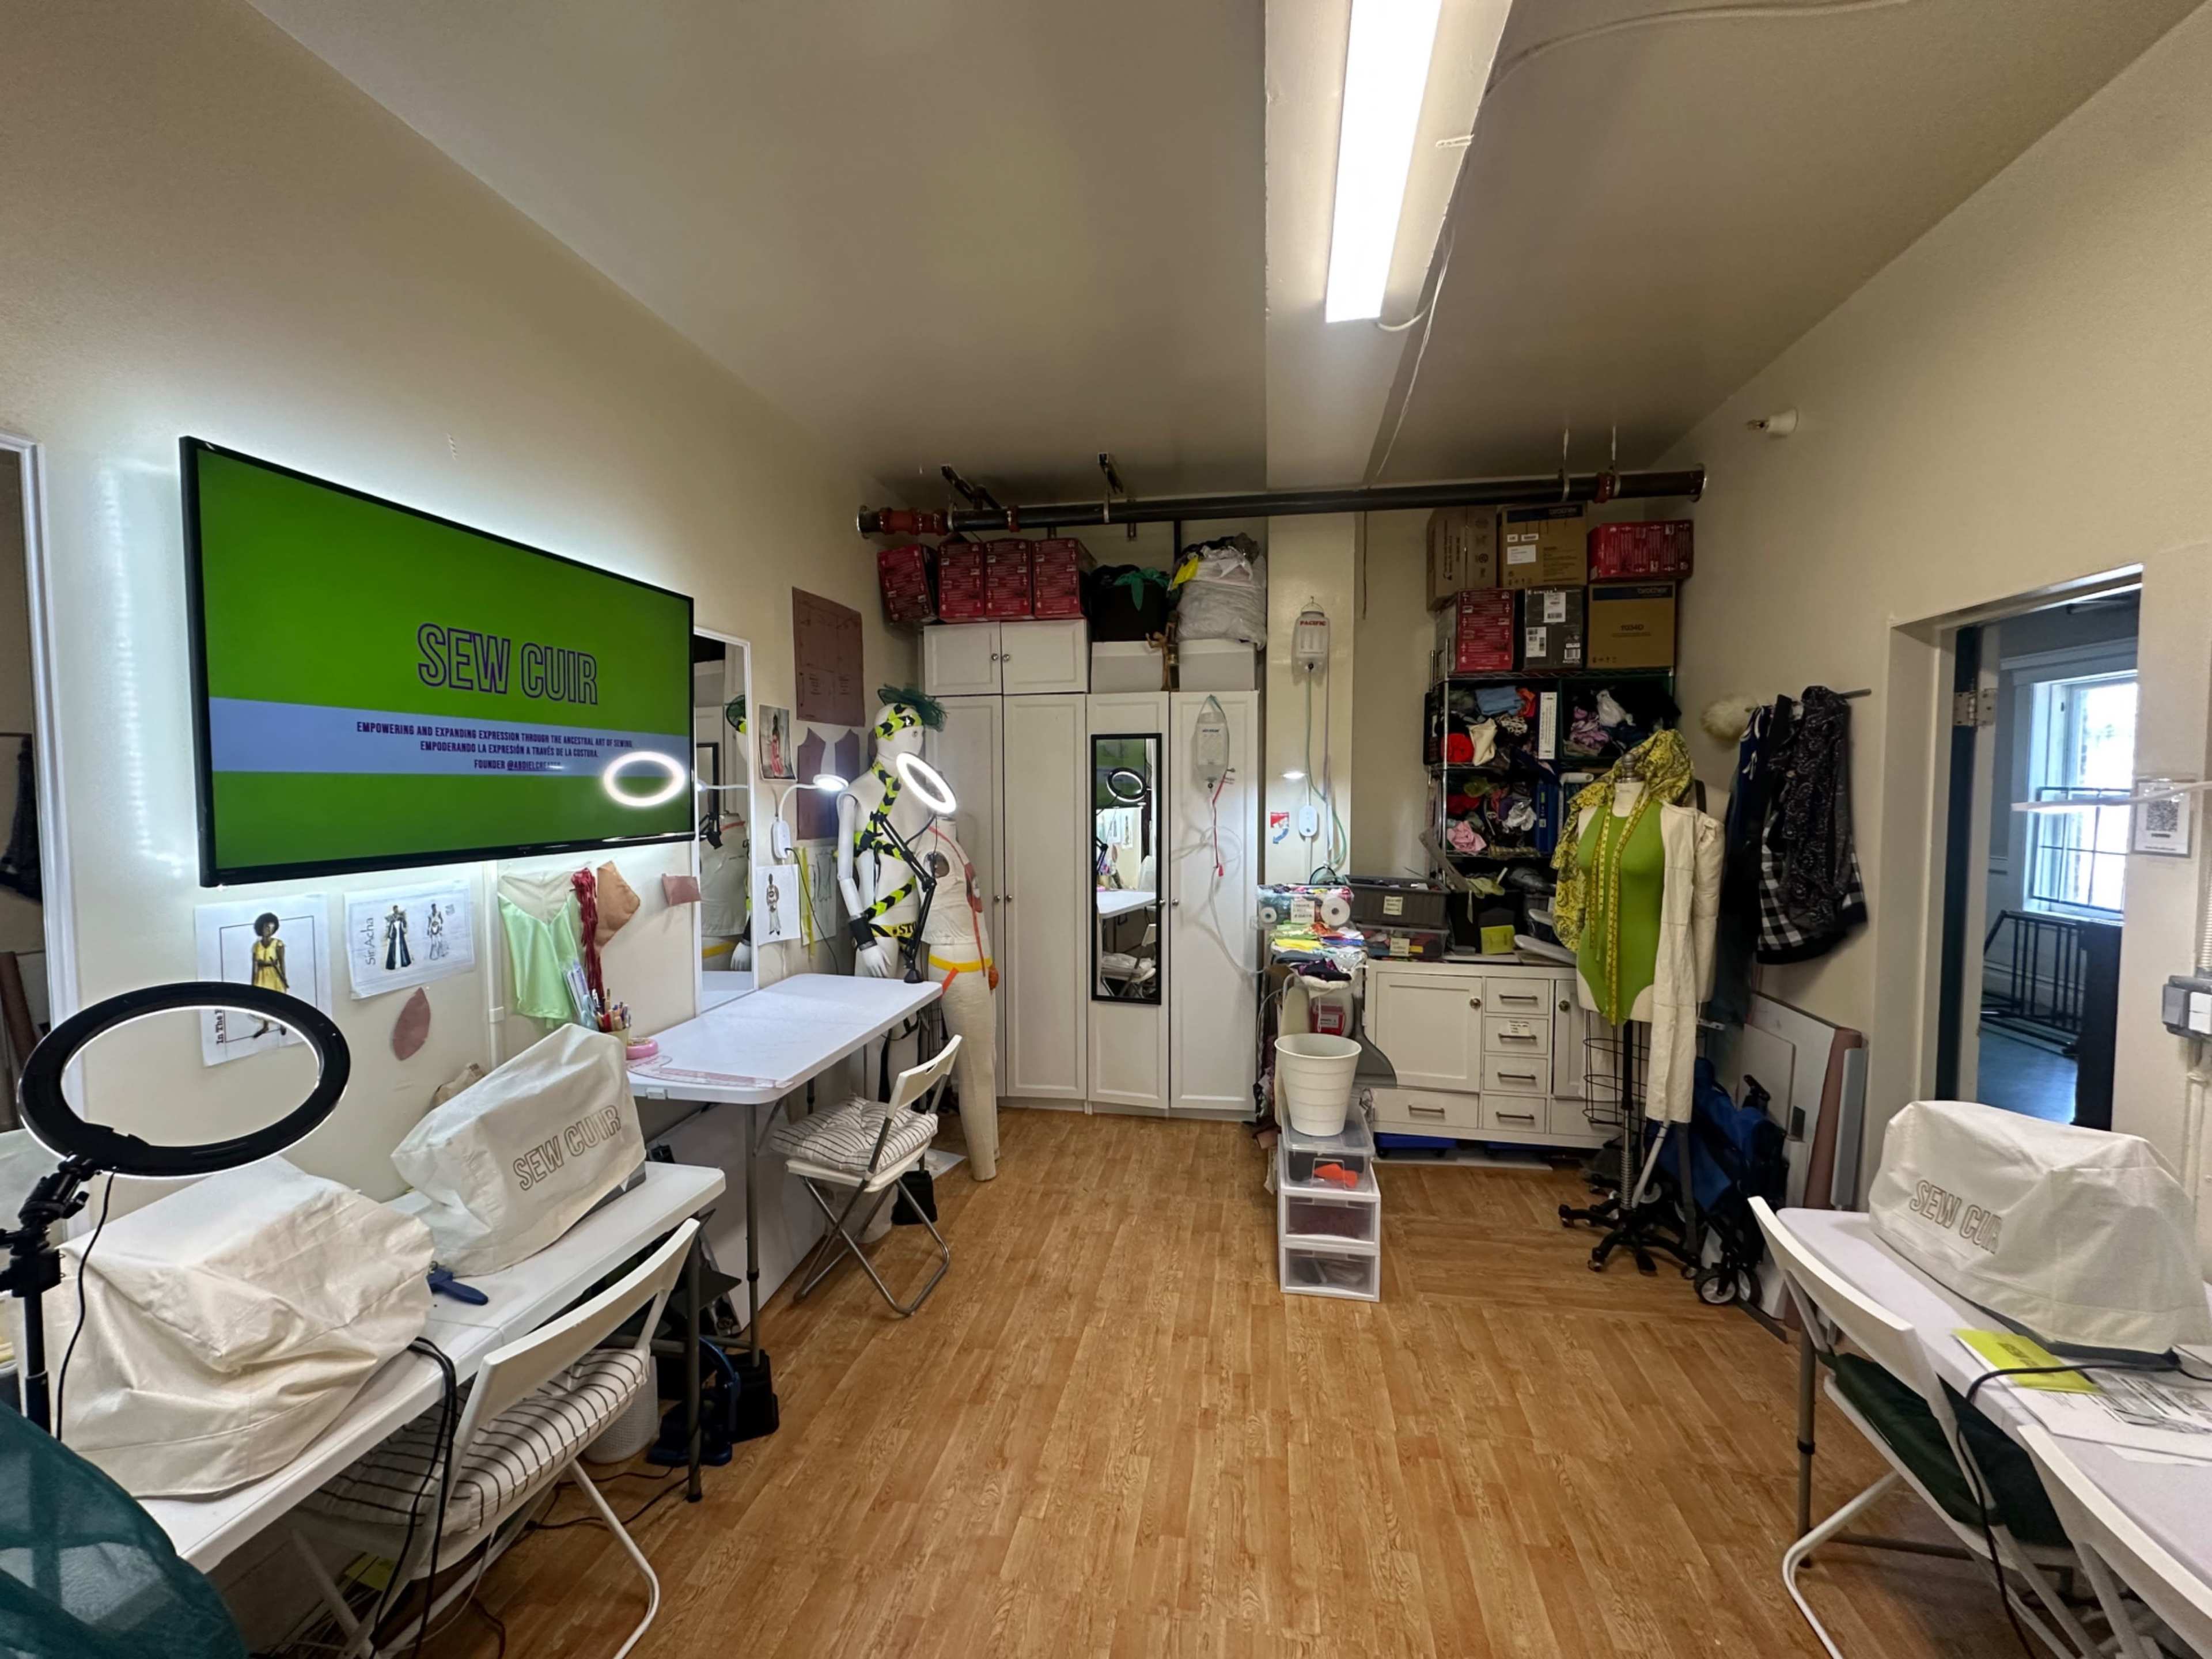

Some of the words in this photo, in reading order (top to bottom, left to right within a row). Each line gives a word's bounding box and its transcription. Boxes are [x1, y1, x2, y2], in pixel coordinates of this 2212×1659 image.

[417, 622, 511, 695] SEW
[520, 642, 598, 705] CUIR
[357, 721, 414, 735] EMPOWERING
[416, 725, 433, 736] AND
[435, 726, 477, 739] EXPANDING
[479, 730, 520, 742] EXPRESSION
[521, 733, 549, 744] THROUGH
[551, 734, 562, 744] THE
[563, 736, 594, 746] ANCESTRAL
[595, 738, 605, 747] ART
[606, 738, 613, 747] OF
[420, 740, 476, 753] EMPODERANDO
[478, 744, 487, 753] LA
[488, 744, 524, 755] EXPRESIÓN
[526, 746, 531, 755] A
[532, 745, 554, 756] TRAVÉS
[556, 748, 564, 756] DE
[565, 748, 573, 757] LA
[474, 759, 506, 770] FOUNDER
[360, 917, 376, 948] Acha
[364, 950, 376, 965] Sir
[215, 1016, 224, 1033] The
[216, 1033, 224, 1044] In
[513, 1135, 565, 1191] SEW
[563, 1104, 622, 1157] CUIR
[1909, 1180, 1963, 1229] SEW
